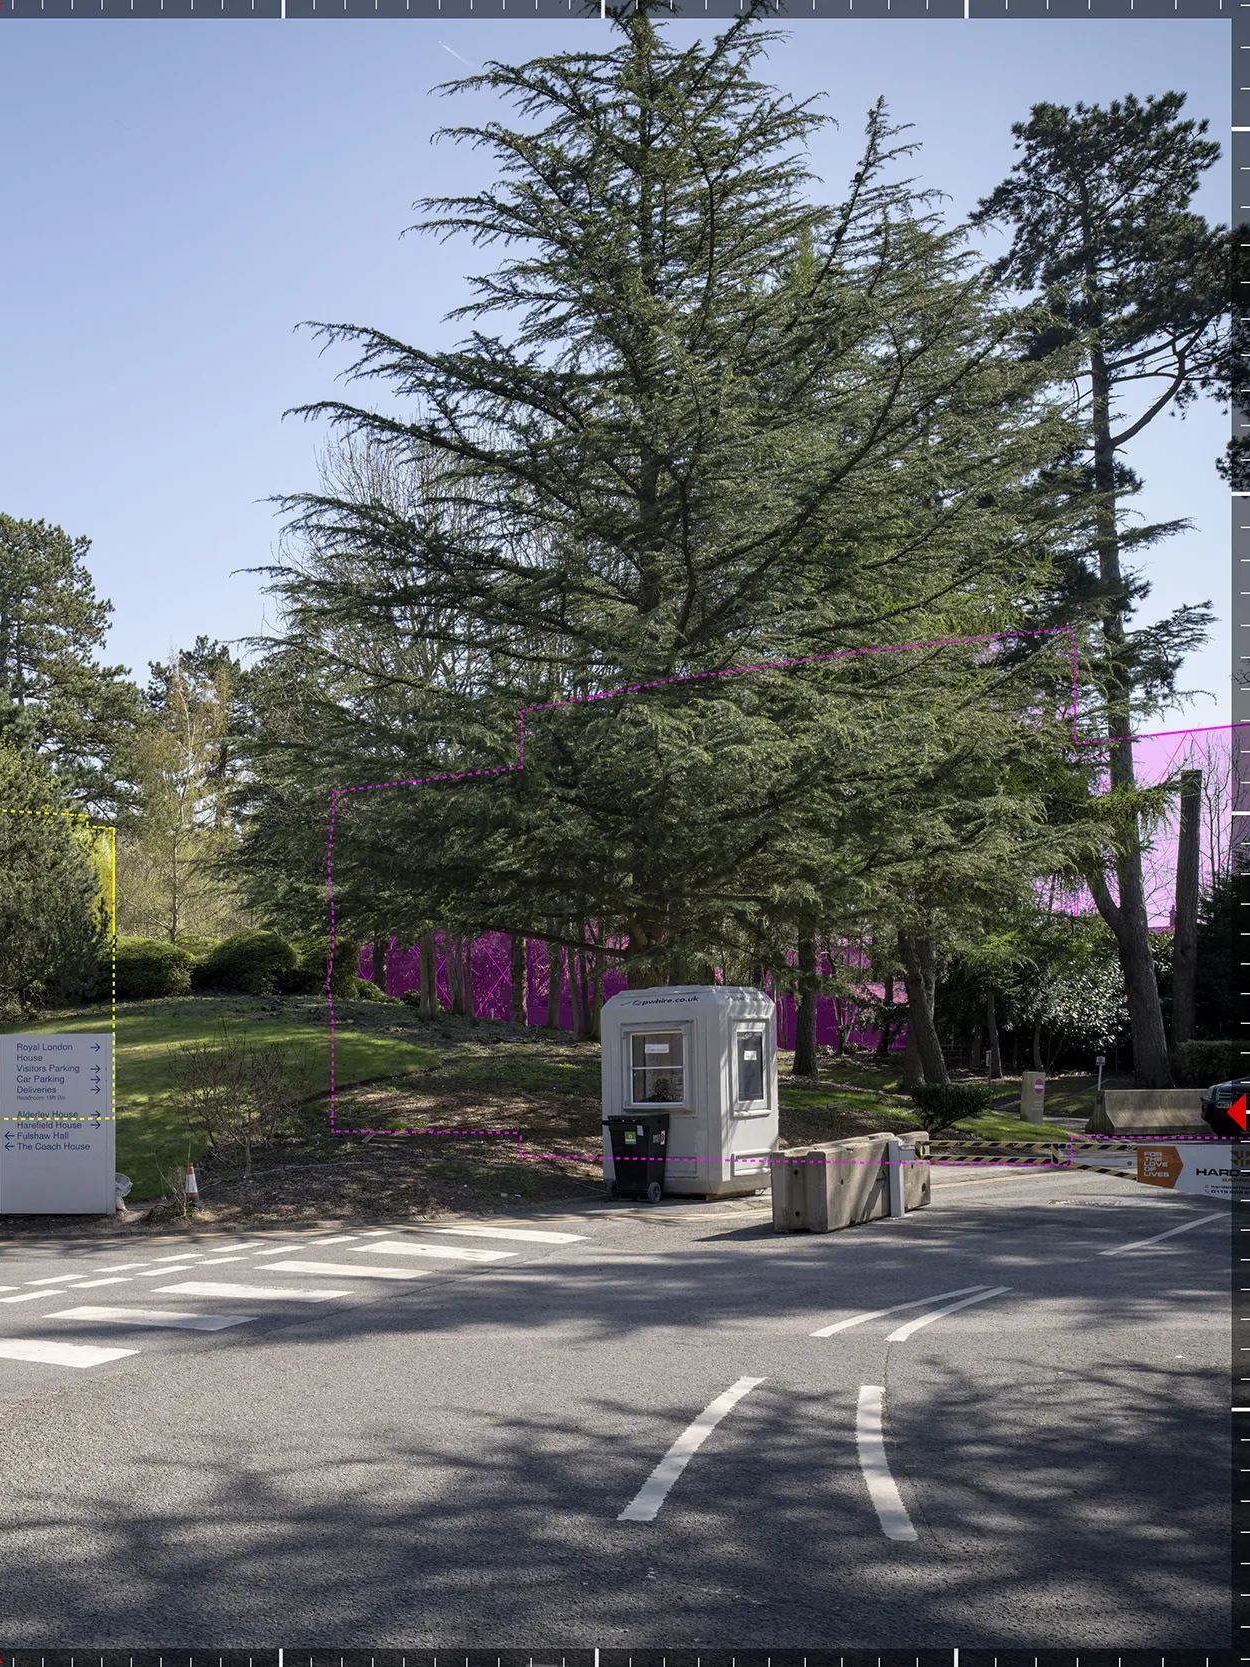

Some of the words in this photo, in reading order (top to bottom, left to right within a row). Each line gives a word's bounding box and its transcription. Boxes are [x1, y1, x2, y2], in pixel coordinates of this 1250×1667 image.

[641, 995, 699, 1006] pwhire.co.uk
[16, 1043, 40, 1052] Royal
[42, 1043, 73, 1051] London
[16, 1054, 43, 1062] House
[16, 1064, 47, 1073] Visitors
[49, 1064, 80, 1074] Parking
[16, 1075, 32, 1083] Car
[34, 1075, 65, 1085] Parking
[16, 1086, 57, 1094] Deliveries
[51, 1111, 79, 1119] House
[16, 1121, 53, 1130] Harefield
[55, 1121, 82, 1130] House
[17, 1132, 51, 1140] Fulshaw
[53, 1132, 69, 1140] Hall
[17, 1143, 33, 1151] The
[35, 1143, 61, 1151] Coach
[63, 1143, 90, 1151] House
